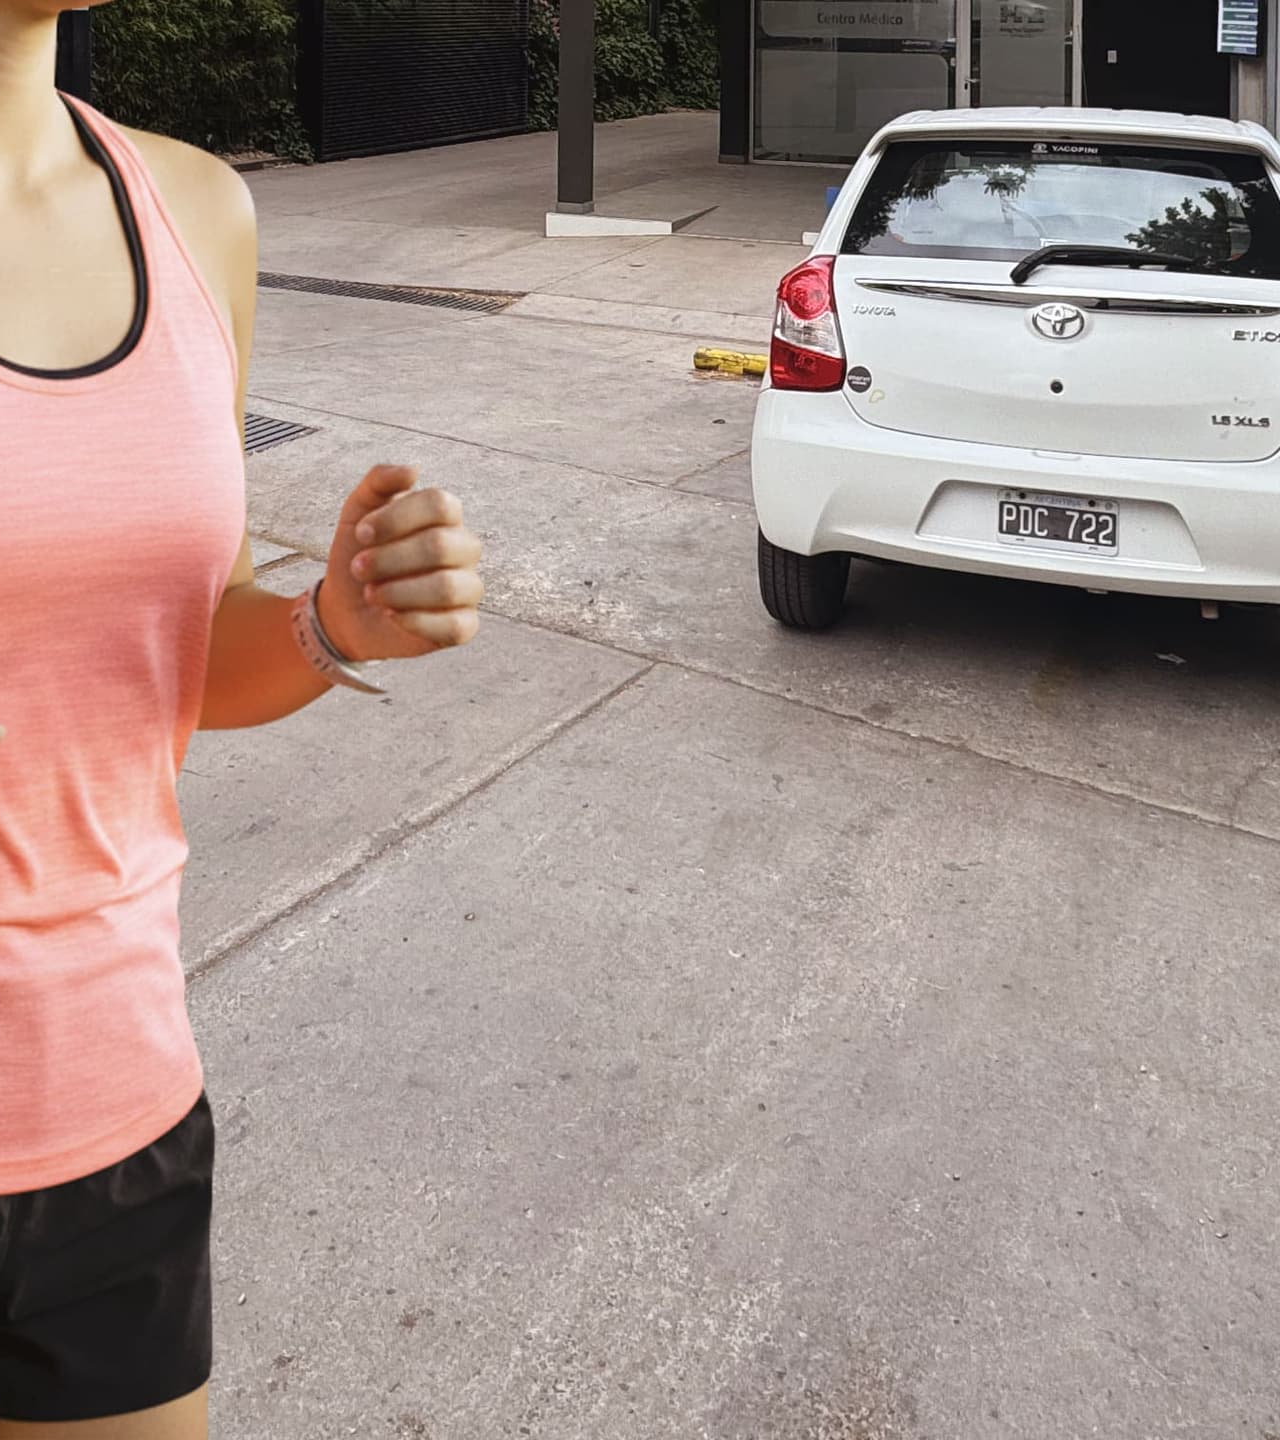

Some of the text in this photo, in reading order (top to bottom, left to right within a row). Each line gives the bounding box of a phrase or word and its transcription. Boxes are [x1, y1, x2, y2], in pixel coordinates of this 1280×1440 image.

[816, 12, 856, 25] Centro
[851, 303, 897, 317] TOYOTA
[1233, 416, 1271, 428] XLS
[1002, 503, 1113, 545] PDC 722
